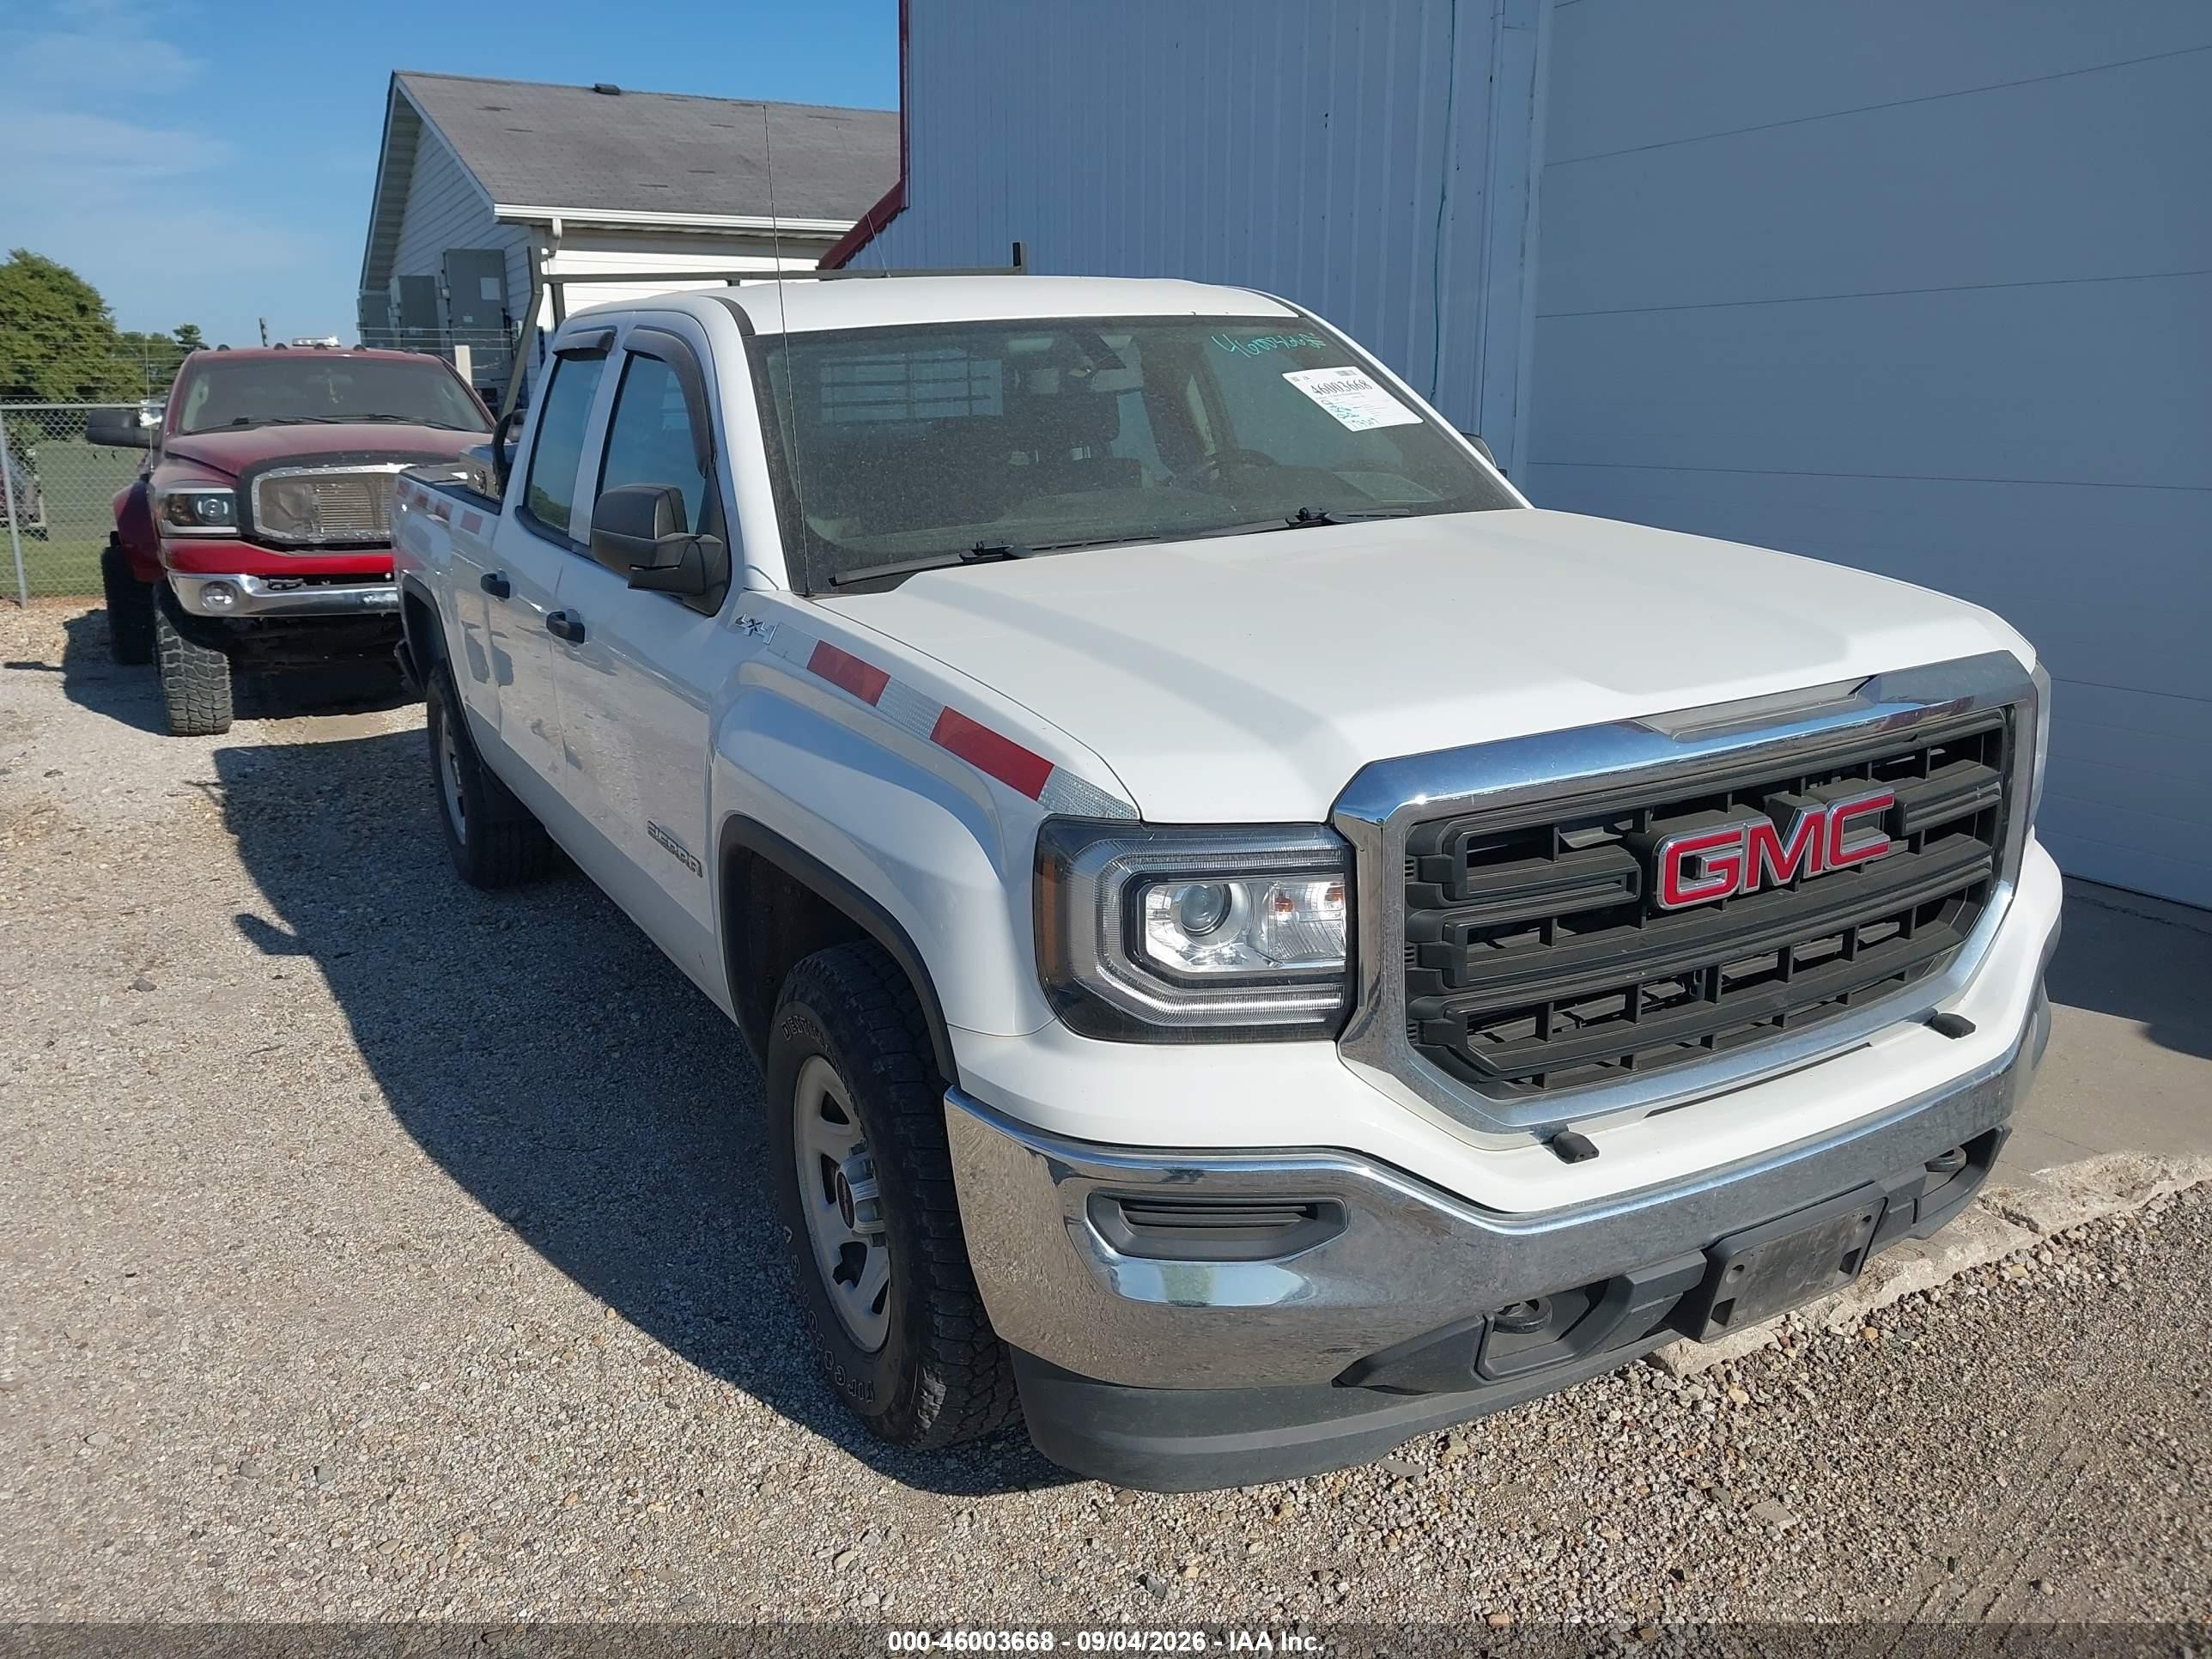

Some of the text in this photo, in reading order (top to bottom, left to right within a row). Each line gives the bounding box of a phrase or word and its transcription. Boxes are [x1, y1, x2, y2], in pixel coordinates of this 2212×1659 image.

[1310, 378, 1372, 395] 46003668
[646, 819, 703, 879] SIERRA
[1656, 786, 1895, 910] GMC
